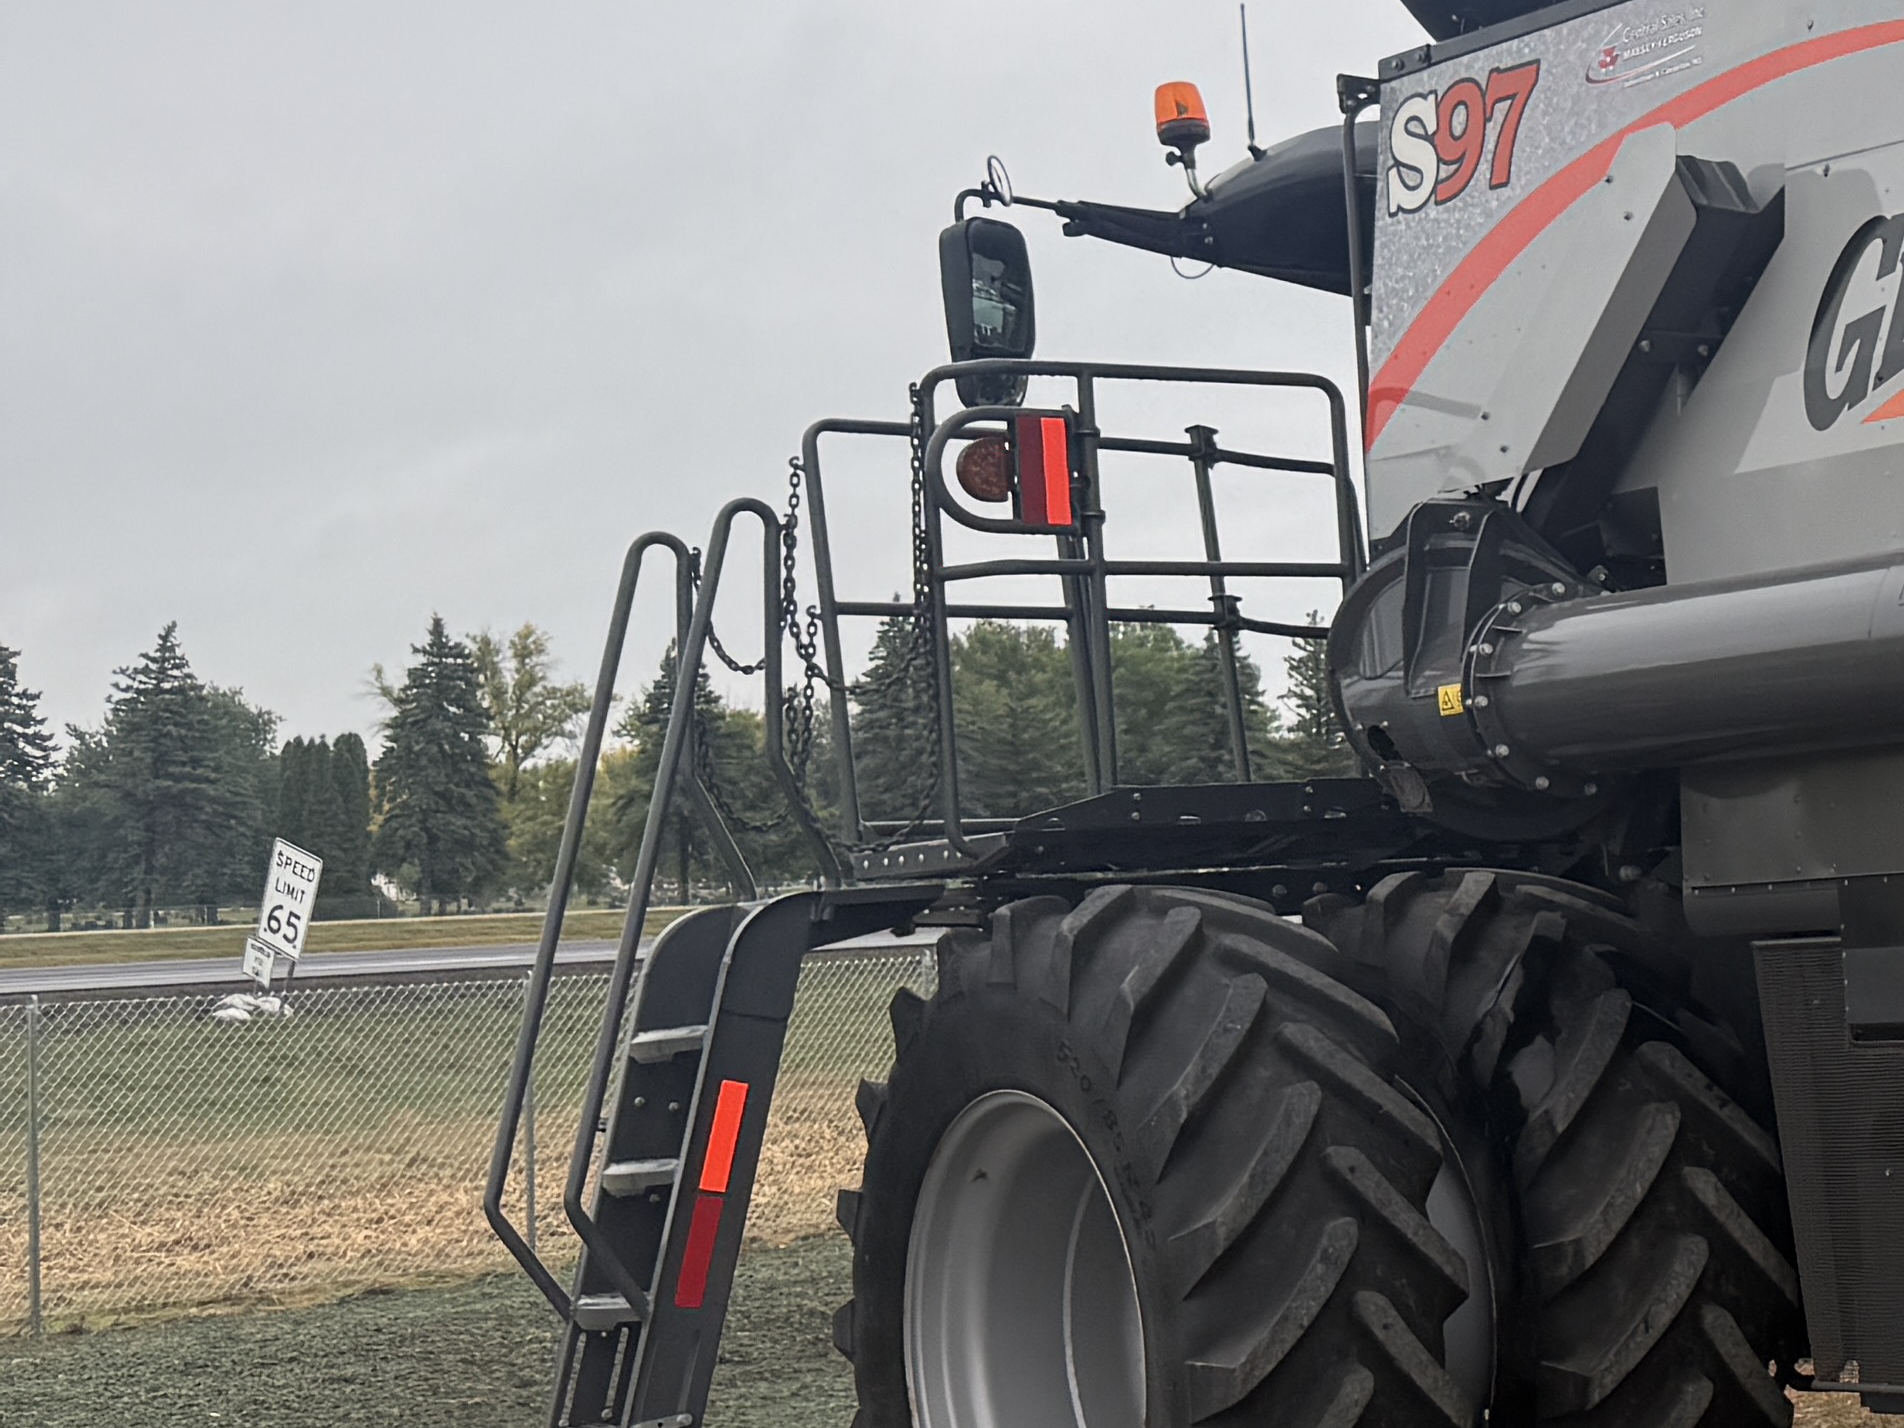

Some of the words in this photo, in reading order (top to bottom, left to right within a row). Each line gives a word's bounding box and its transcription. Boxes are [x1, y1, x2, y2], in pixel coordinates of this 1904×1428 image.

[1387, 58, 1541, 218] S97
[275, 849, 316, 883] SPEED
[274, 876, 306, 904] LIMIT
[267, 904, 302, 945] 65
